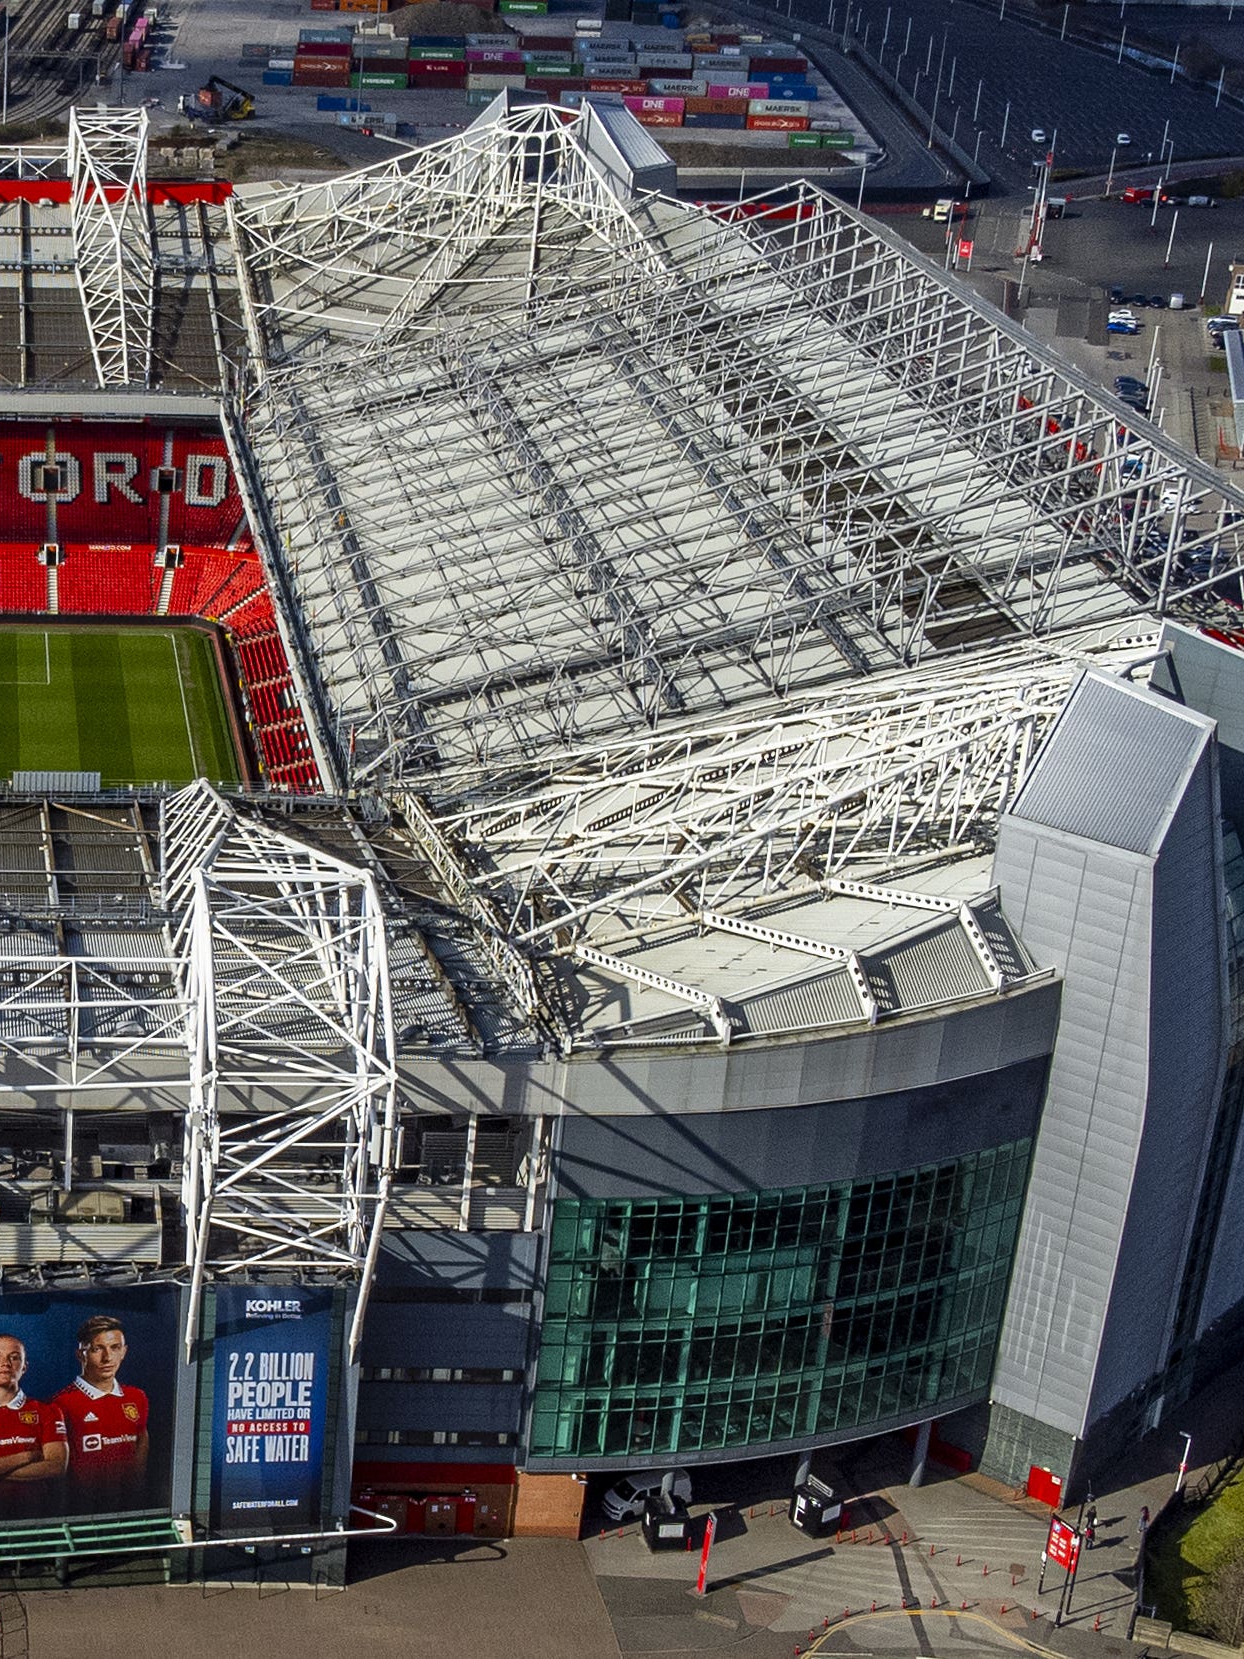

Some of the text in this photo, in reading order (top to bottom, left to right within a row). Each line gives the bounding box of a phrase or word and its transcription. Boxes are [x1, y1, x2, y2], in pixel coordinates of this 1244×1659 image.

[589, 42, 622, 50] MAERSK
[598, 67, 632, 75] MAERSK
[728, 87, 750, 97] ONE
[642, 99, 665, 109] ONE
[765, 105, 802, 113] MAERSK
[246, 1299, 301, 1312] KOHLER
[228, 1352, 315, 1382] 2.2 BILLION
[227, 1381, 312, 1408] PEOPLE
[227, 1408, 311, 1421] HAVE LIMITED OR
[231, 1422, 305, 1433] NO ACCESS TO
[226, 1435, 309, 1464] SAFE WATER
[232, 1499, 299, 1509] SAFEWATERFORALL.COM
